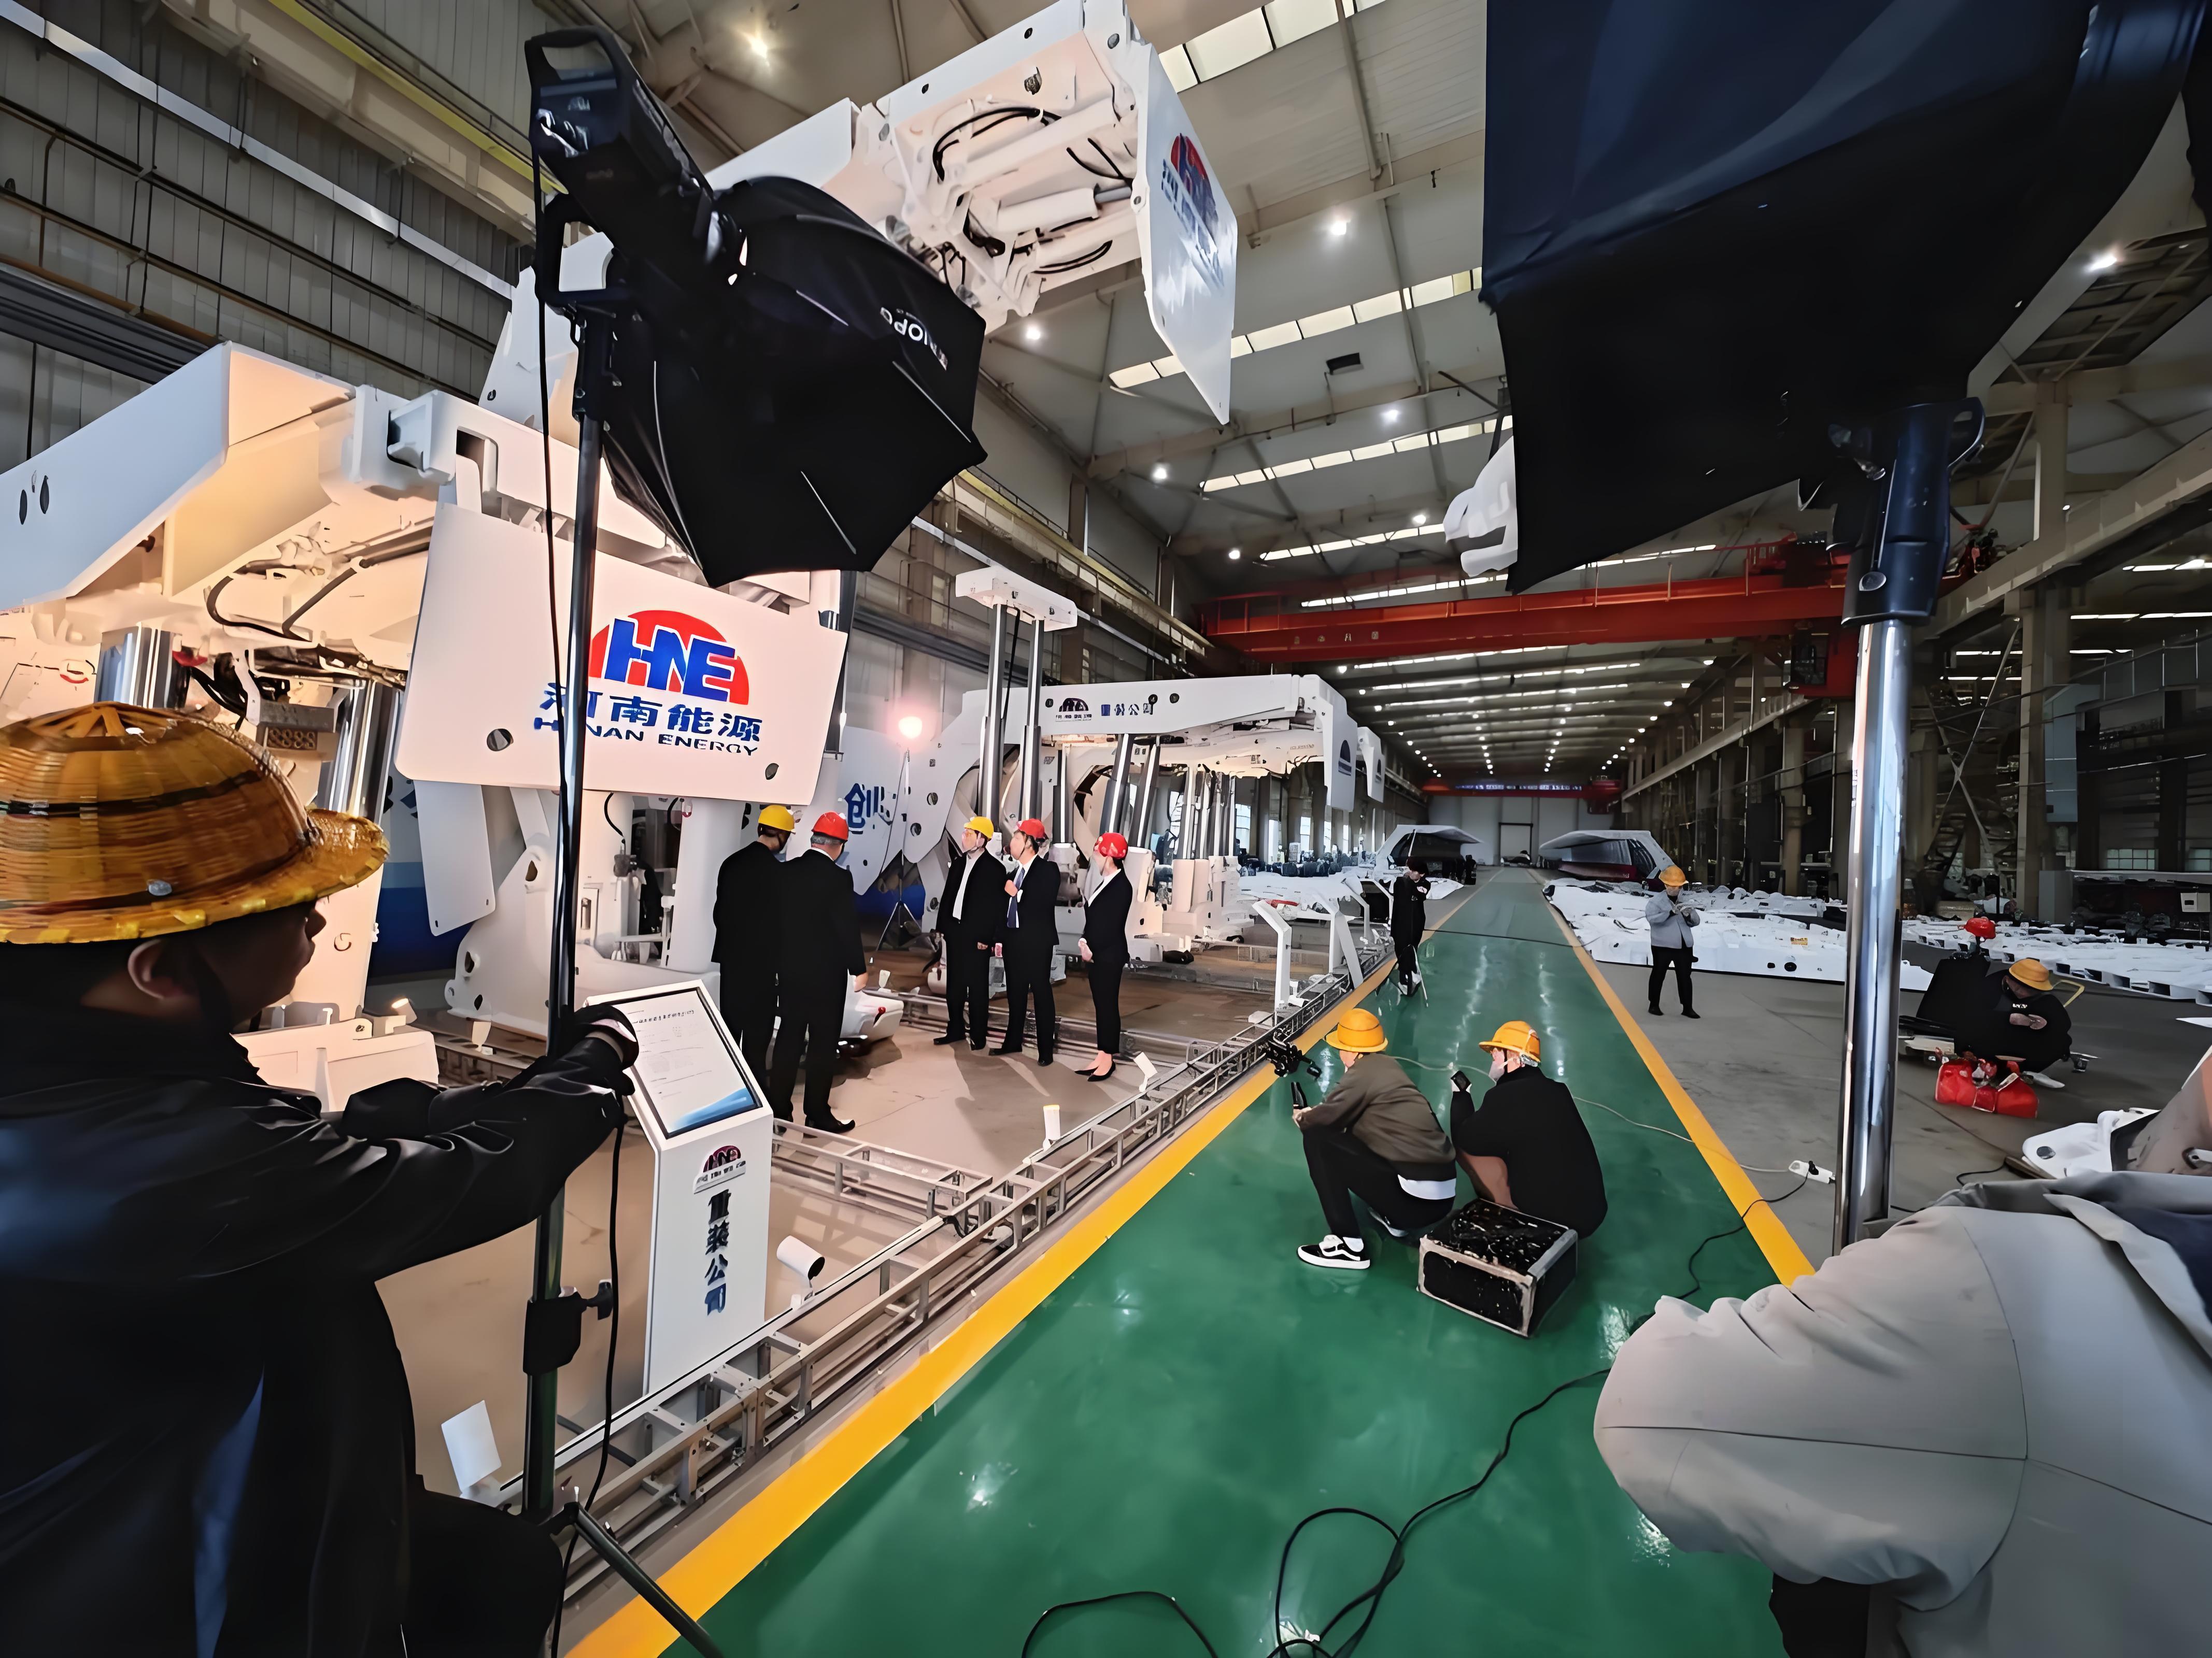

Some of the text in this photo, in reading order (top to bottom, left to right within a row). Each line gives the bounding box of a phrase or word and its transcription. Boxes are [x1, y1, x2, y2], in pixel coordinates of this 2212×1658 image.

[604, 618, 735, 702] HNE
[533, 717, 758, 756] HNAN ENERGY
